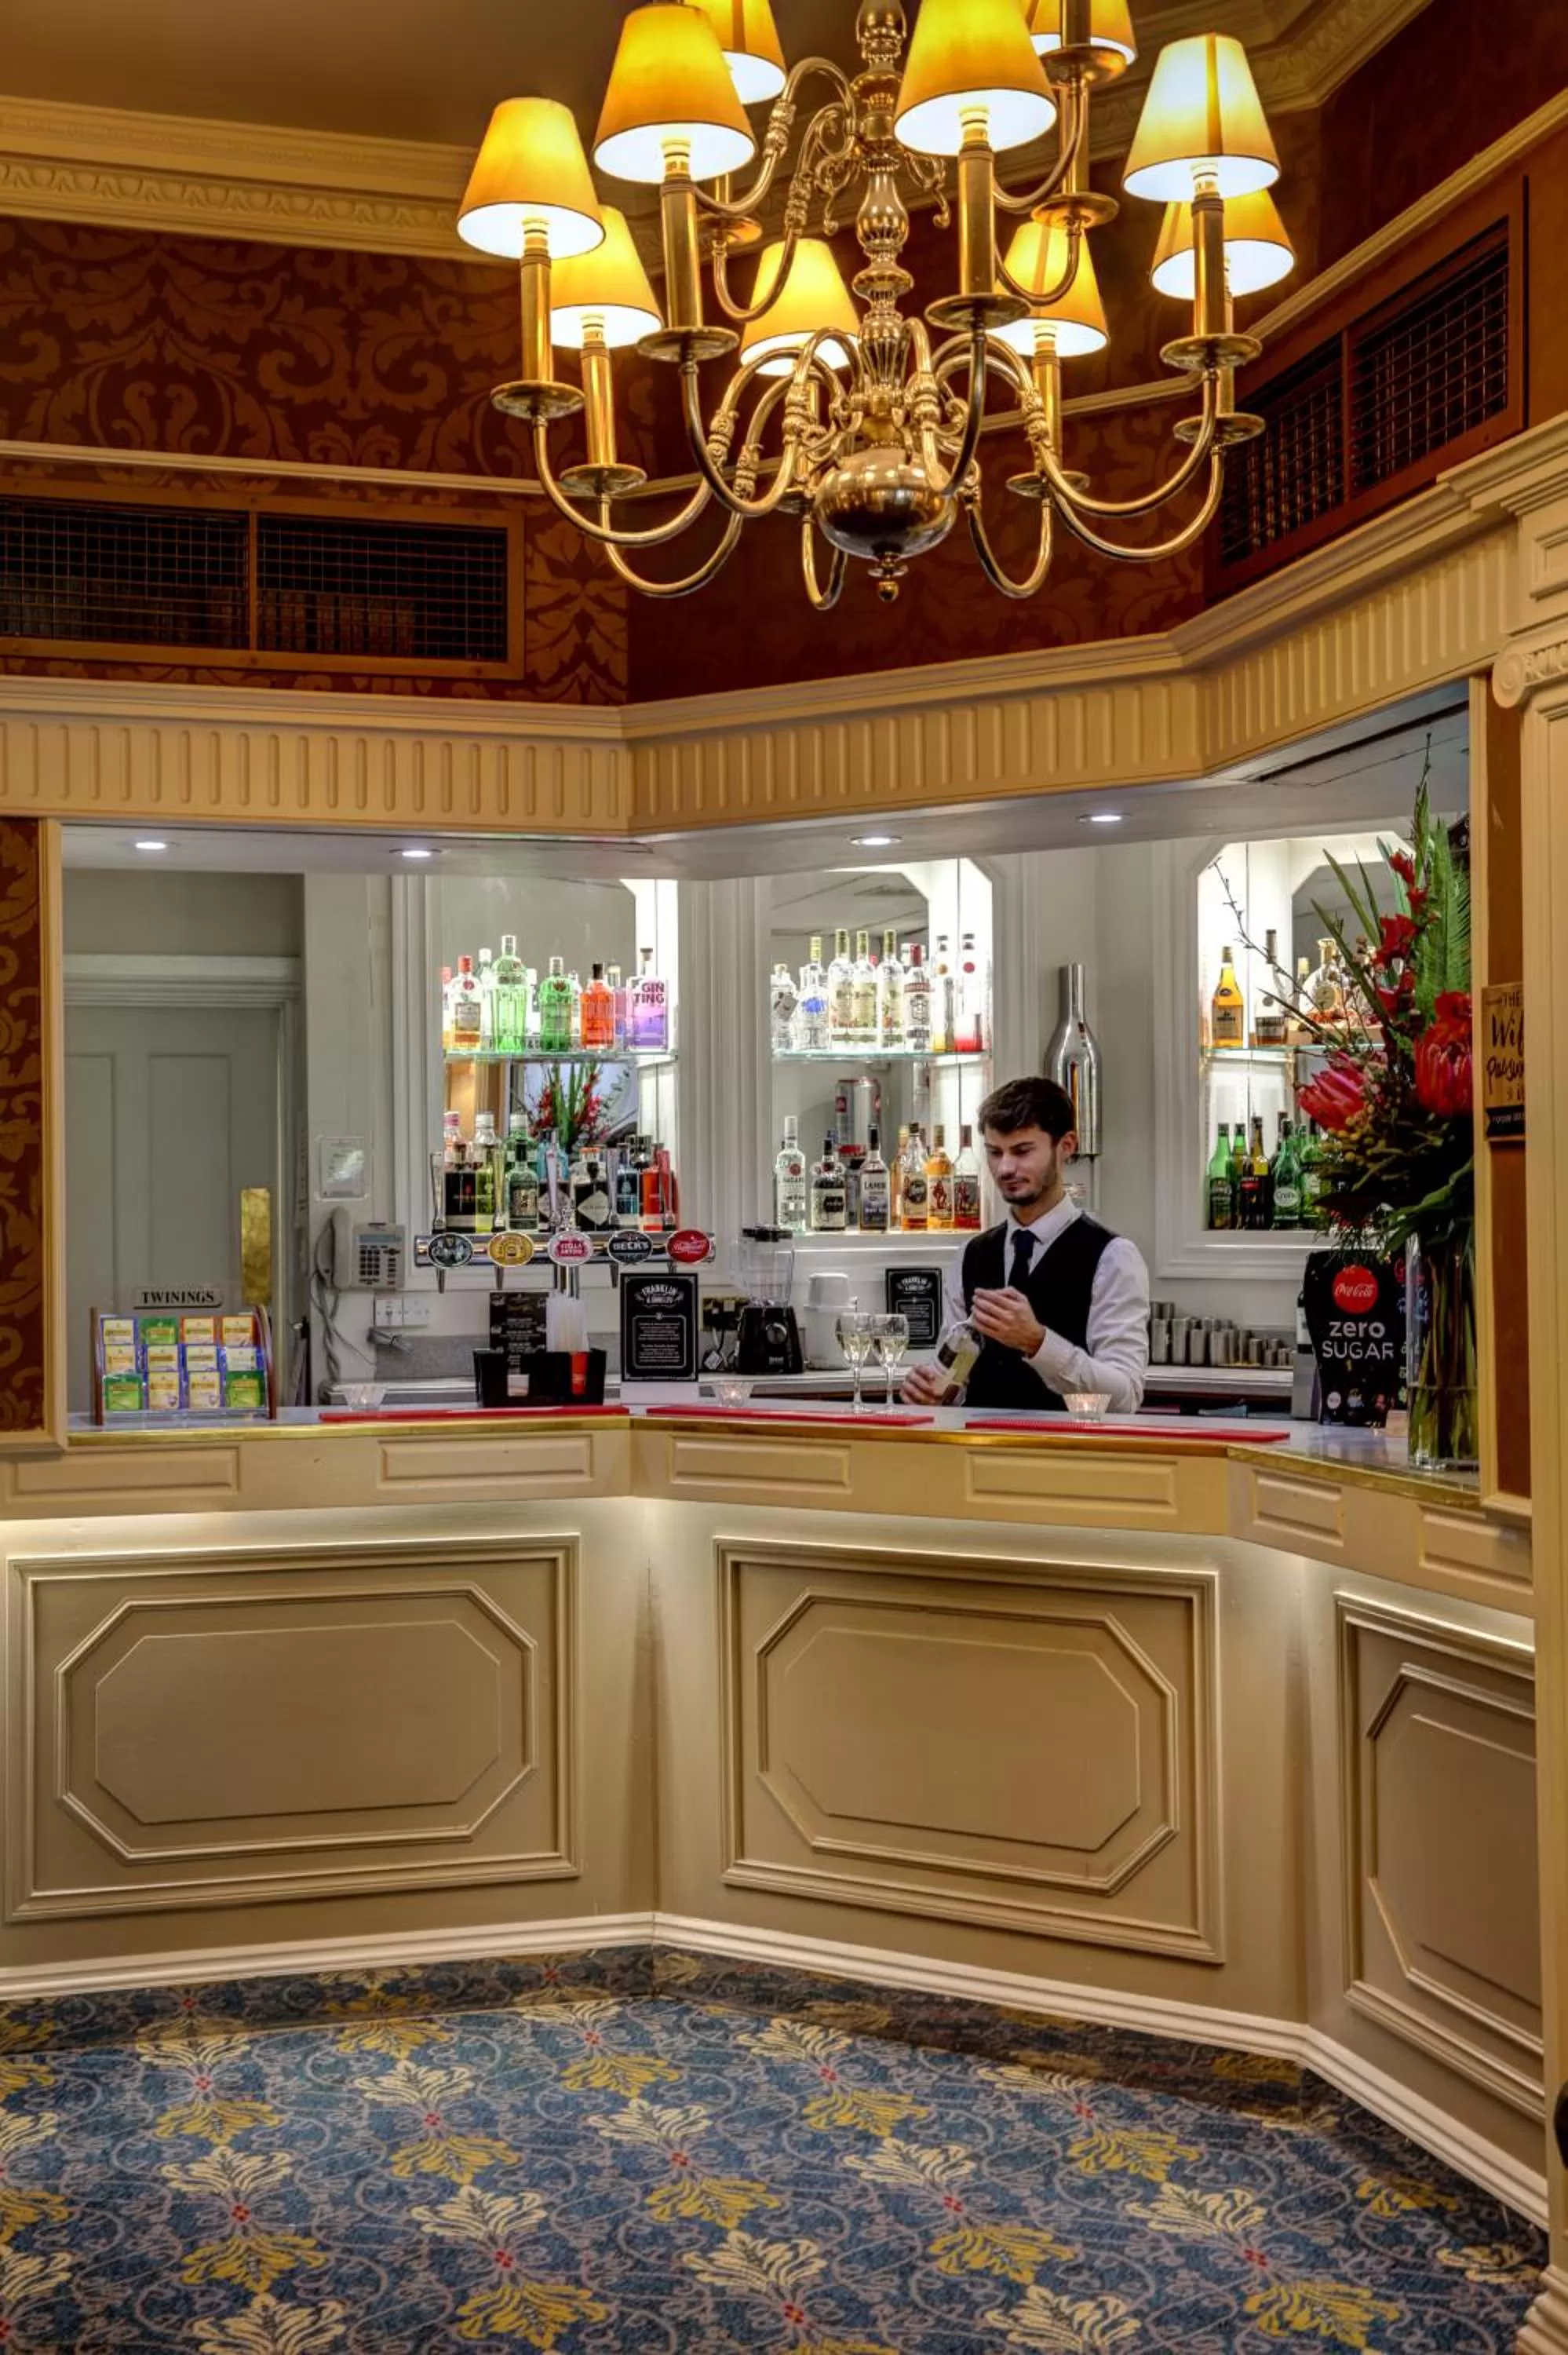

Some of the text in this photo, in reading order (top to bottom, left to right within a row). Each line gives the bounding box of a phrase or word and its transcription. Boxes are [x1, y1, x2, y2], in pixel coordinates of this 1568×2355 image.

[641, 982, 665, 993] GIN
[633, 993, 665, 1004] TING
[612, 1242, 649, 1251] BECK'S
[141, 1291, 214, 1304] TWININGS
[1329, 1321, 1386, 1338] zero
[1322, 1341, 1394, 1360] SUGAR
